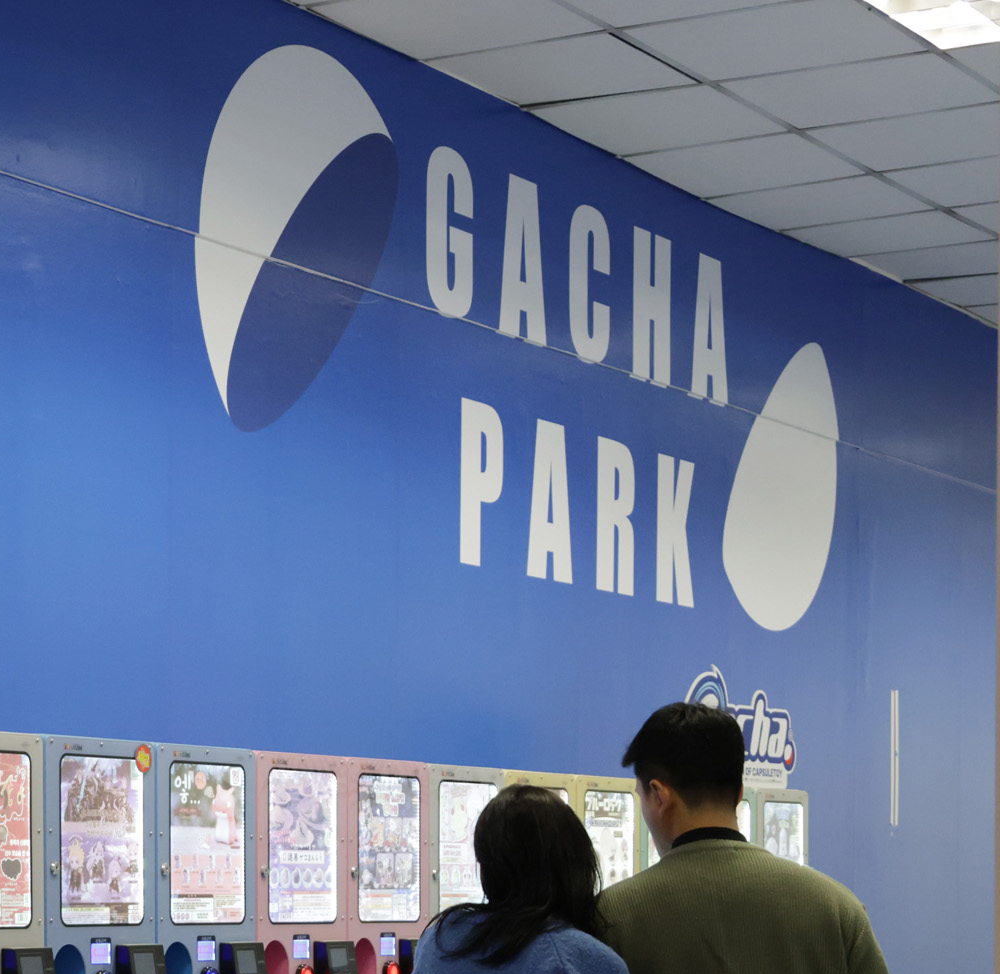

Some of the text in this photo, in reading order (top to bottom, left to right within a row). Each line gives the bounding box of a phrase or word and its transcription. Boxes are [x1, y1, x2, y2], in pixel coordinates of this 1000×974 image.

[426, 146, 728, 406] GACHA
[459, 397, 695, 608] PARK
[745, 767, 782, 779] OF CAPSULETOY
